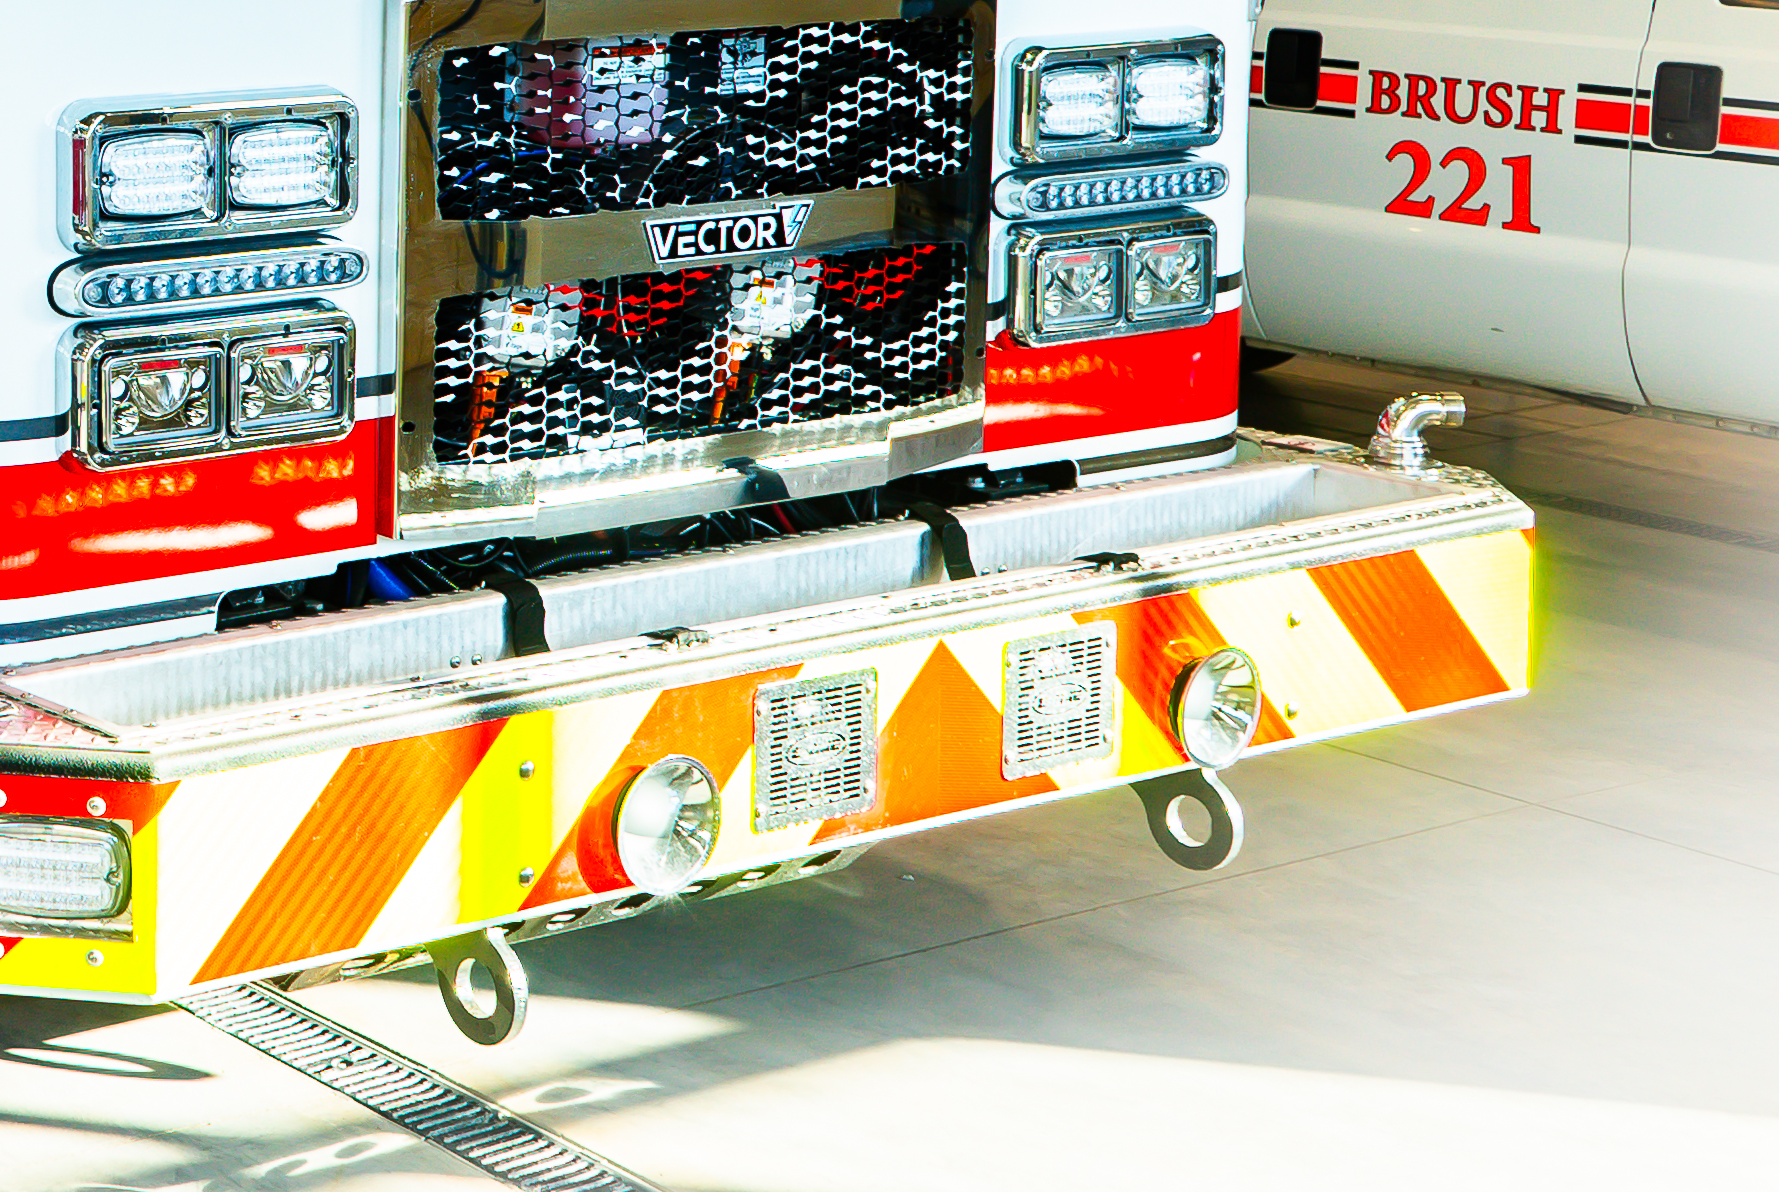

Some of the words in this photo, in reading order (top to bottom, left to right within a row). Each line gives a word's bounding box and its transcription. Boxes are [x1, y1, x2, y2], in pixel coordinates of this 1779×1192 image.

[1364, 69, 1566, 135] BRUSH
[1384, 140, 1541, 234] 221
[653, 216, 778, 258] VECTOR
